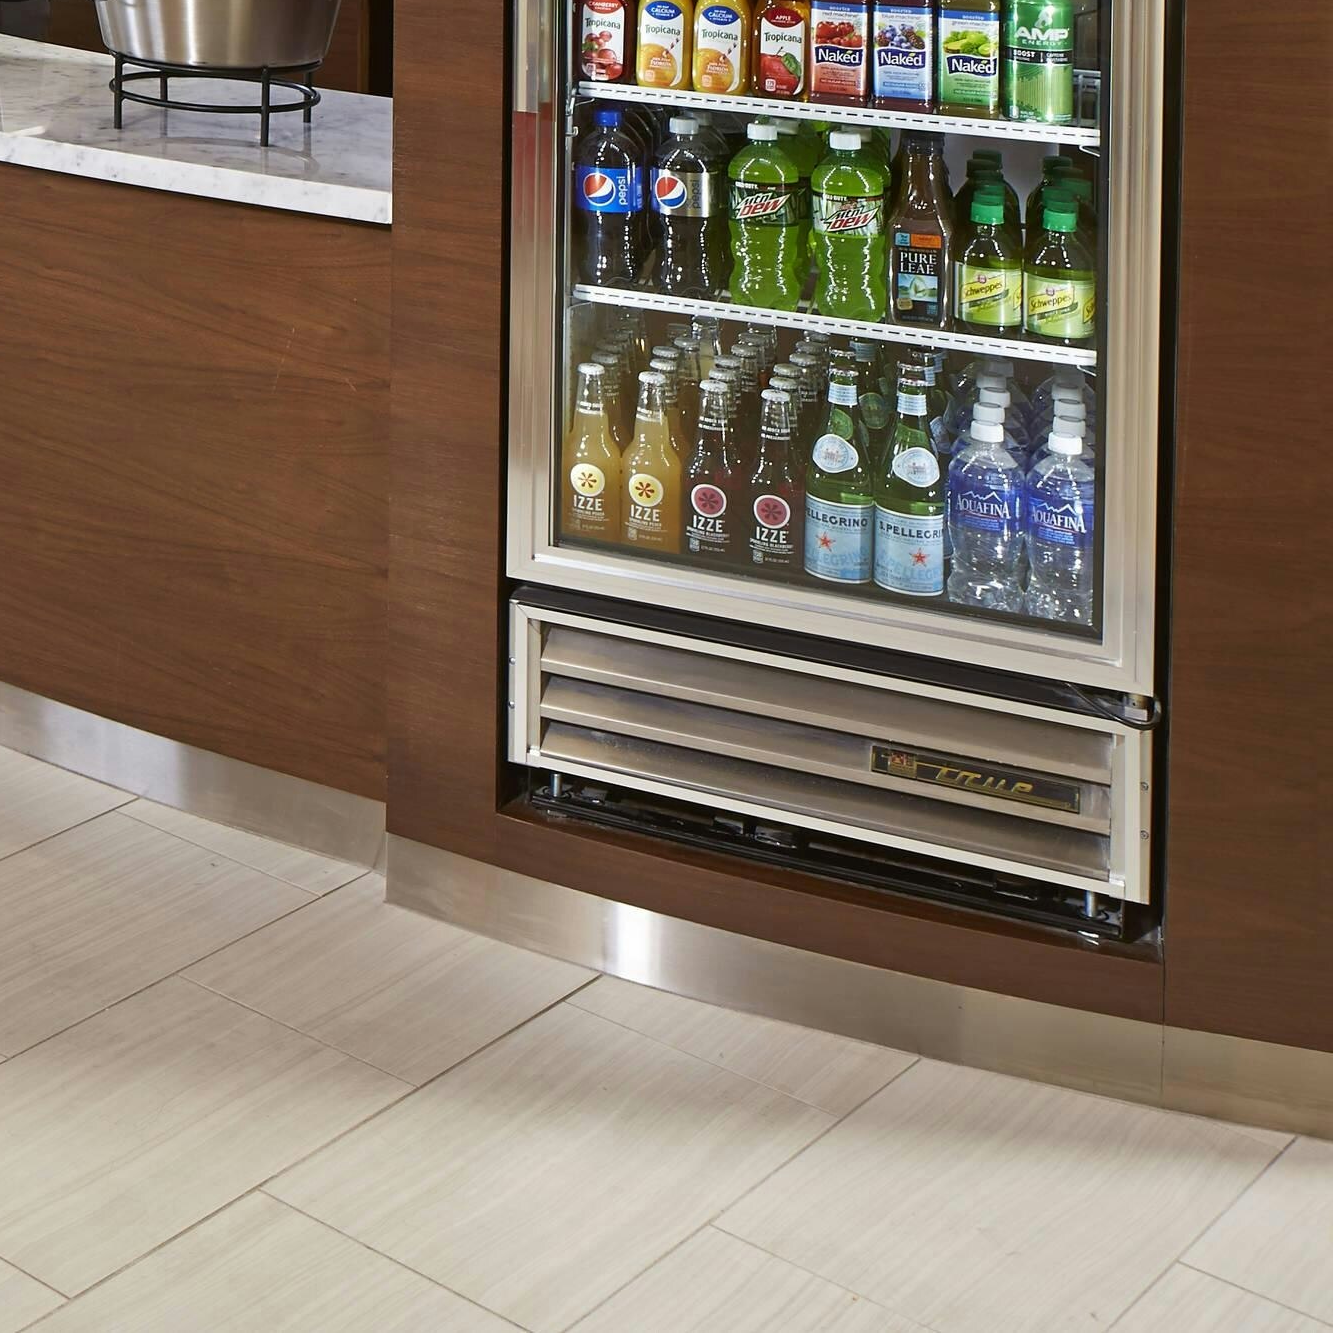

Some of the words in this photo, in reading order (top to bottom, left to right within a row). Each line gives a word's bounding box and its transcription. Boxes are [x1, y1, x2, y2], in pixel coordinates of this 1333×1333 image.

[585, 17, 621, 30] Tropicana
[645, 23, 681, 36] Tropicana
[701, 28, 738, 41] Tropicana
[764, 31, 802, 44] Tropicana
[1016, 26, 1069, 41] AMP
[818, 48, 860, 64] Naked
[880, 51, 923, 67] Naked
[1013, 49, 1036, 58] BOOST
[951, 58, 995, 74] Naked
[618, 176, 629, 206] pepsi
[692, 179, 702, 209] pepsi
[900, 251, 937, 265] PURE
[900, 264, 935, 275] LEAF
[962, 282, 1003, 298] Schweppes
[1030, 294, 1071, 312] Schweppes
[573, 494, 603, 511] IZZE
[956, 494, 1011, 519] AQUAFINA
[630, 504, 661, 522] IZZE
[1033, 507, 1087, 534] AQUAFINA
[692, 515, 724, 533] IZZE
[879, 521, 943, 539] S.PELLEGRI
[756, 526, 788, 544] IZZE
